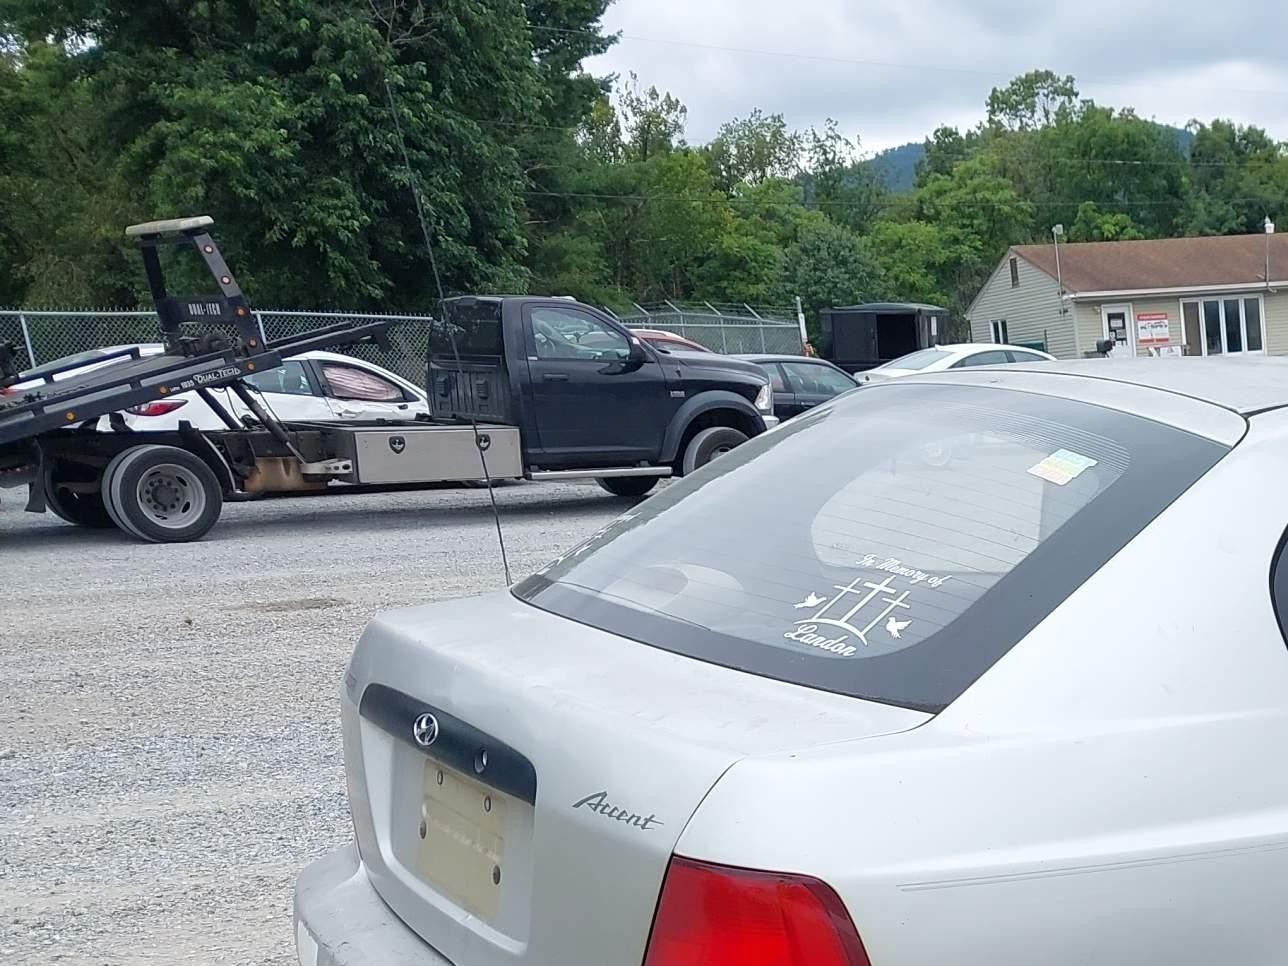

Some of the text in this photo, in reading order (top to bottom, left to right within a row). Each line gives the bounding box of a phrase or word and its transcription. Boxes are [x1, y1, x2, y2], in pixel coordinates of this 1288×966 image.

[876, 557, 930, 585] Memory
[927, 574, 953, 588] of
[783, 623, 857, 657] Landon
[571, 791, 664, 830] Accent
